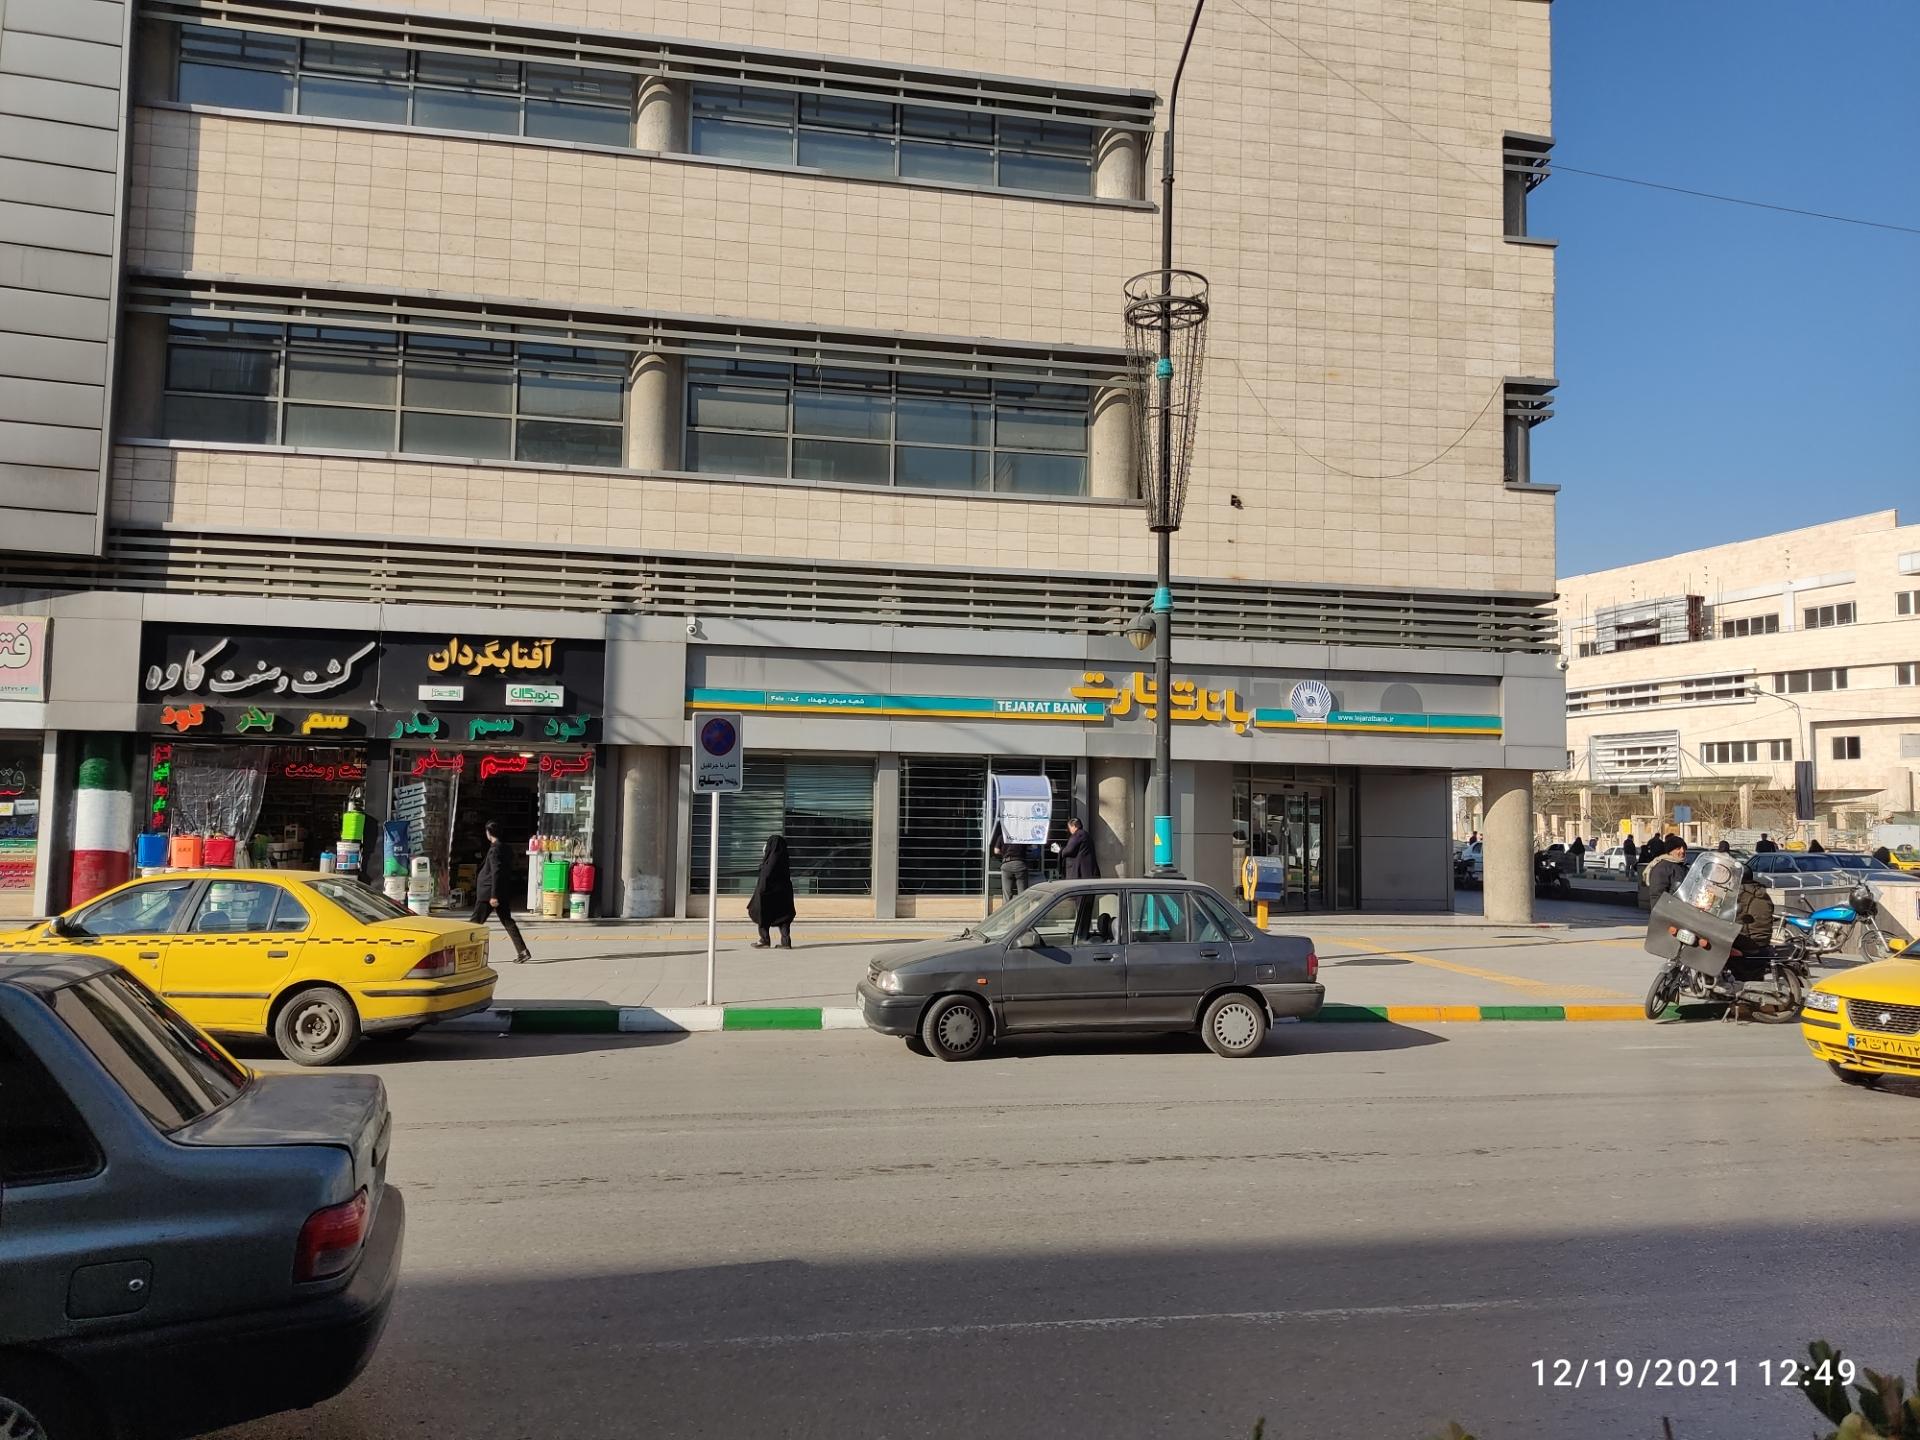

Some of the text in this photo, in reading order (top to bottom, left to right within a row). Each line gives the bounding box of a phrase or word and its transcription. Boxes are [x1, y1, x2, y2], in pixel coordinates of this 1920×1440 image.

[145, 637, 376, 693] کشت و صنعت کاوه
[427, 637, 557, 676] آفتابگردان
[159, 703, 350, 735] سم بذر کود
[997, 700, 1088, 715] TEJARAT BANK
[388, 710, 591, 743] کود سم بذر
[285, 763, 325, 779] صنعت
[412, 747, 593, 780] کود سم بذر
